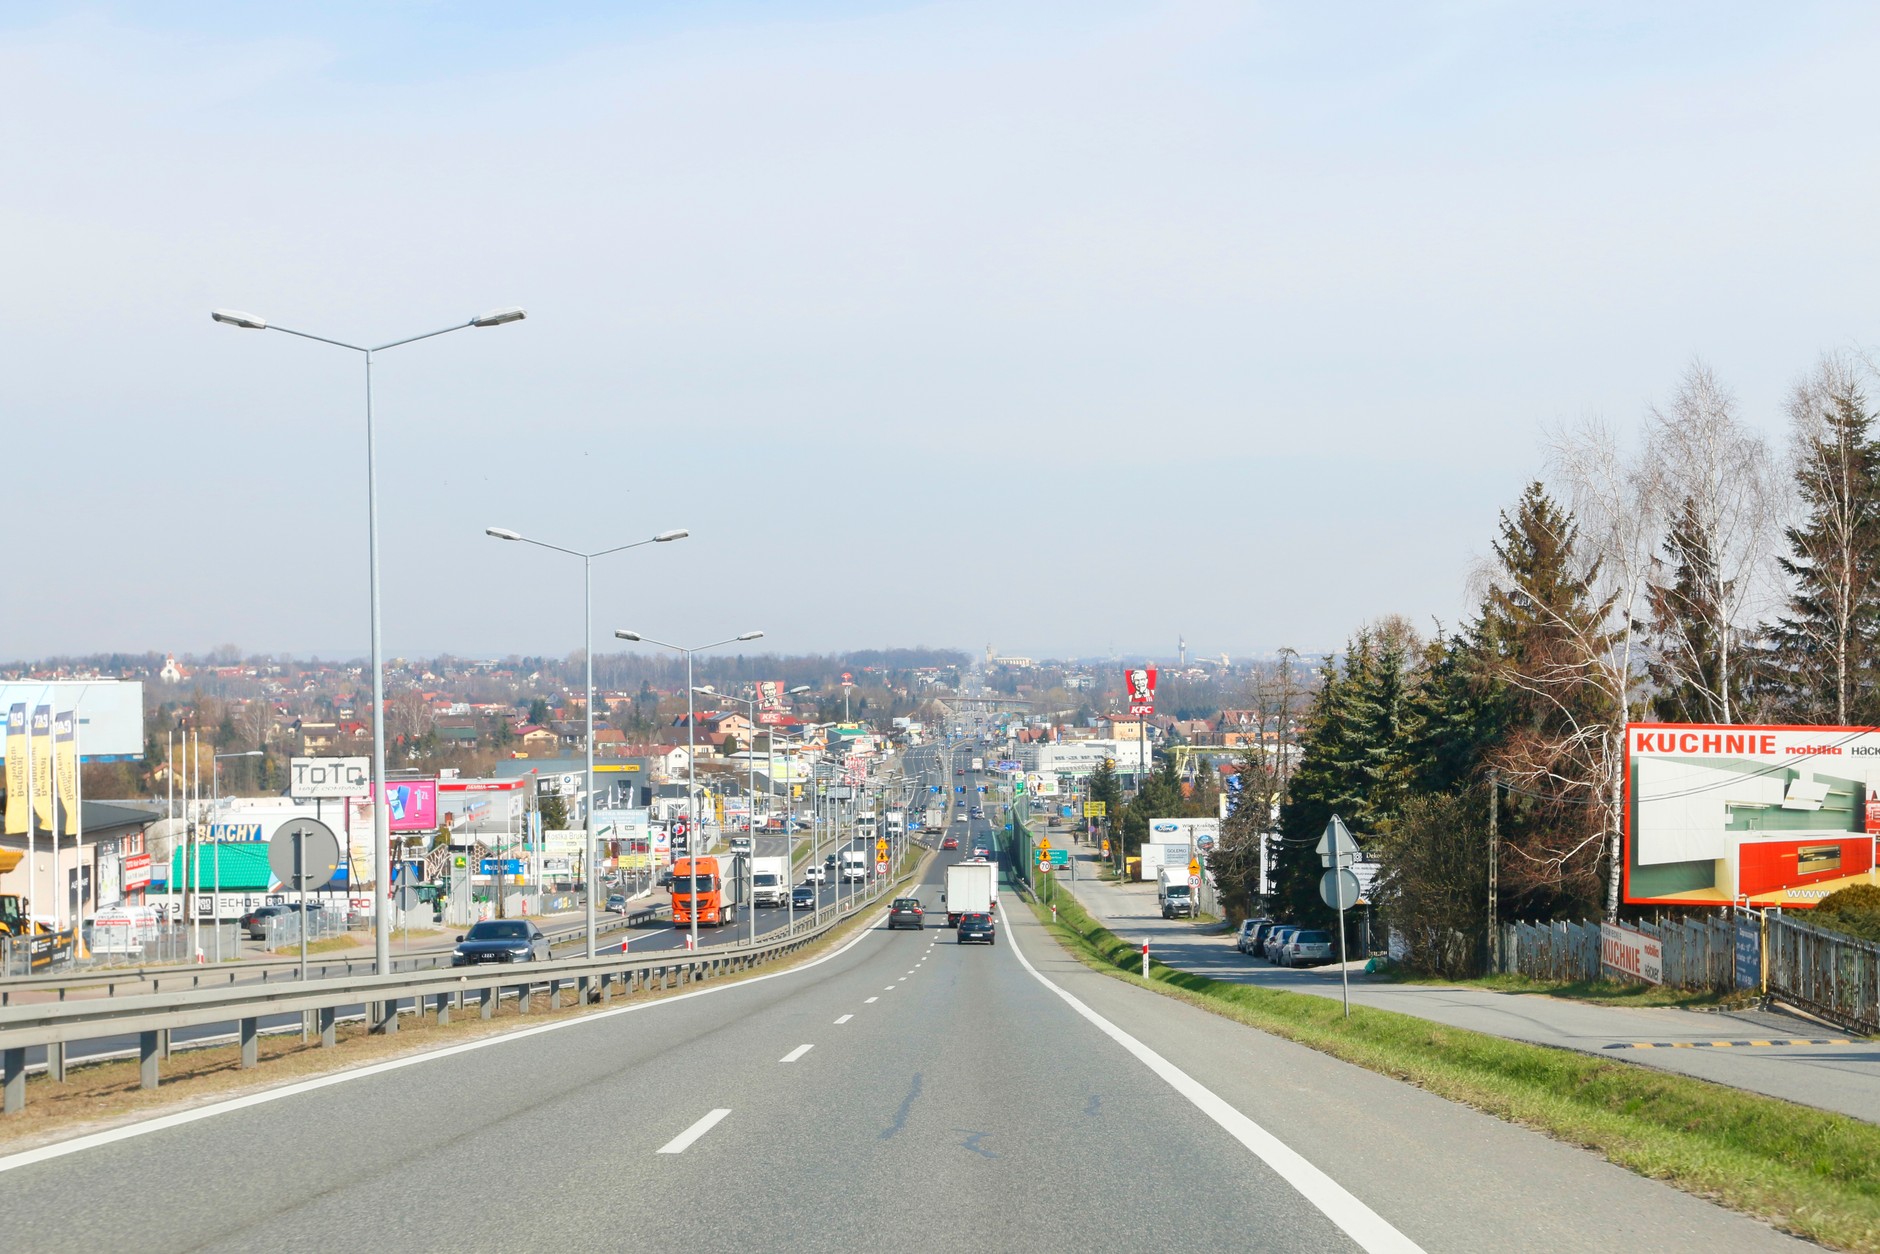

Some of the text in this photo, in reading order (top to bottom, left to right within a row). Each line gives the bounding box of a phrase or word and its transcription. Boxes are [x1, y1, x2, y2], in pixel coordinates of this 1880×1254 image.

[1637, 733, 1775, 754] KUCHNIE
[1786, 745, 1842, 755] nobilia
[198, 824, 259, 841] BLACHY
[220, 899, 259, 907] ECHOS
[1603, 939, 1640, 973] KUCHNIE
